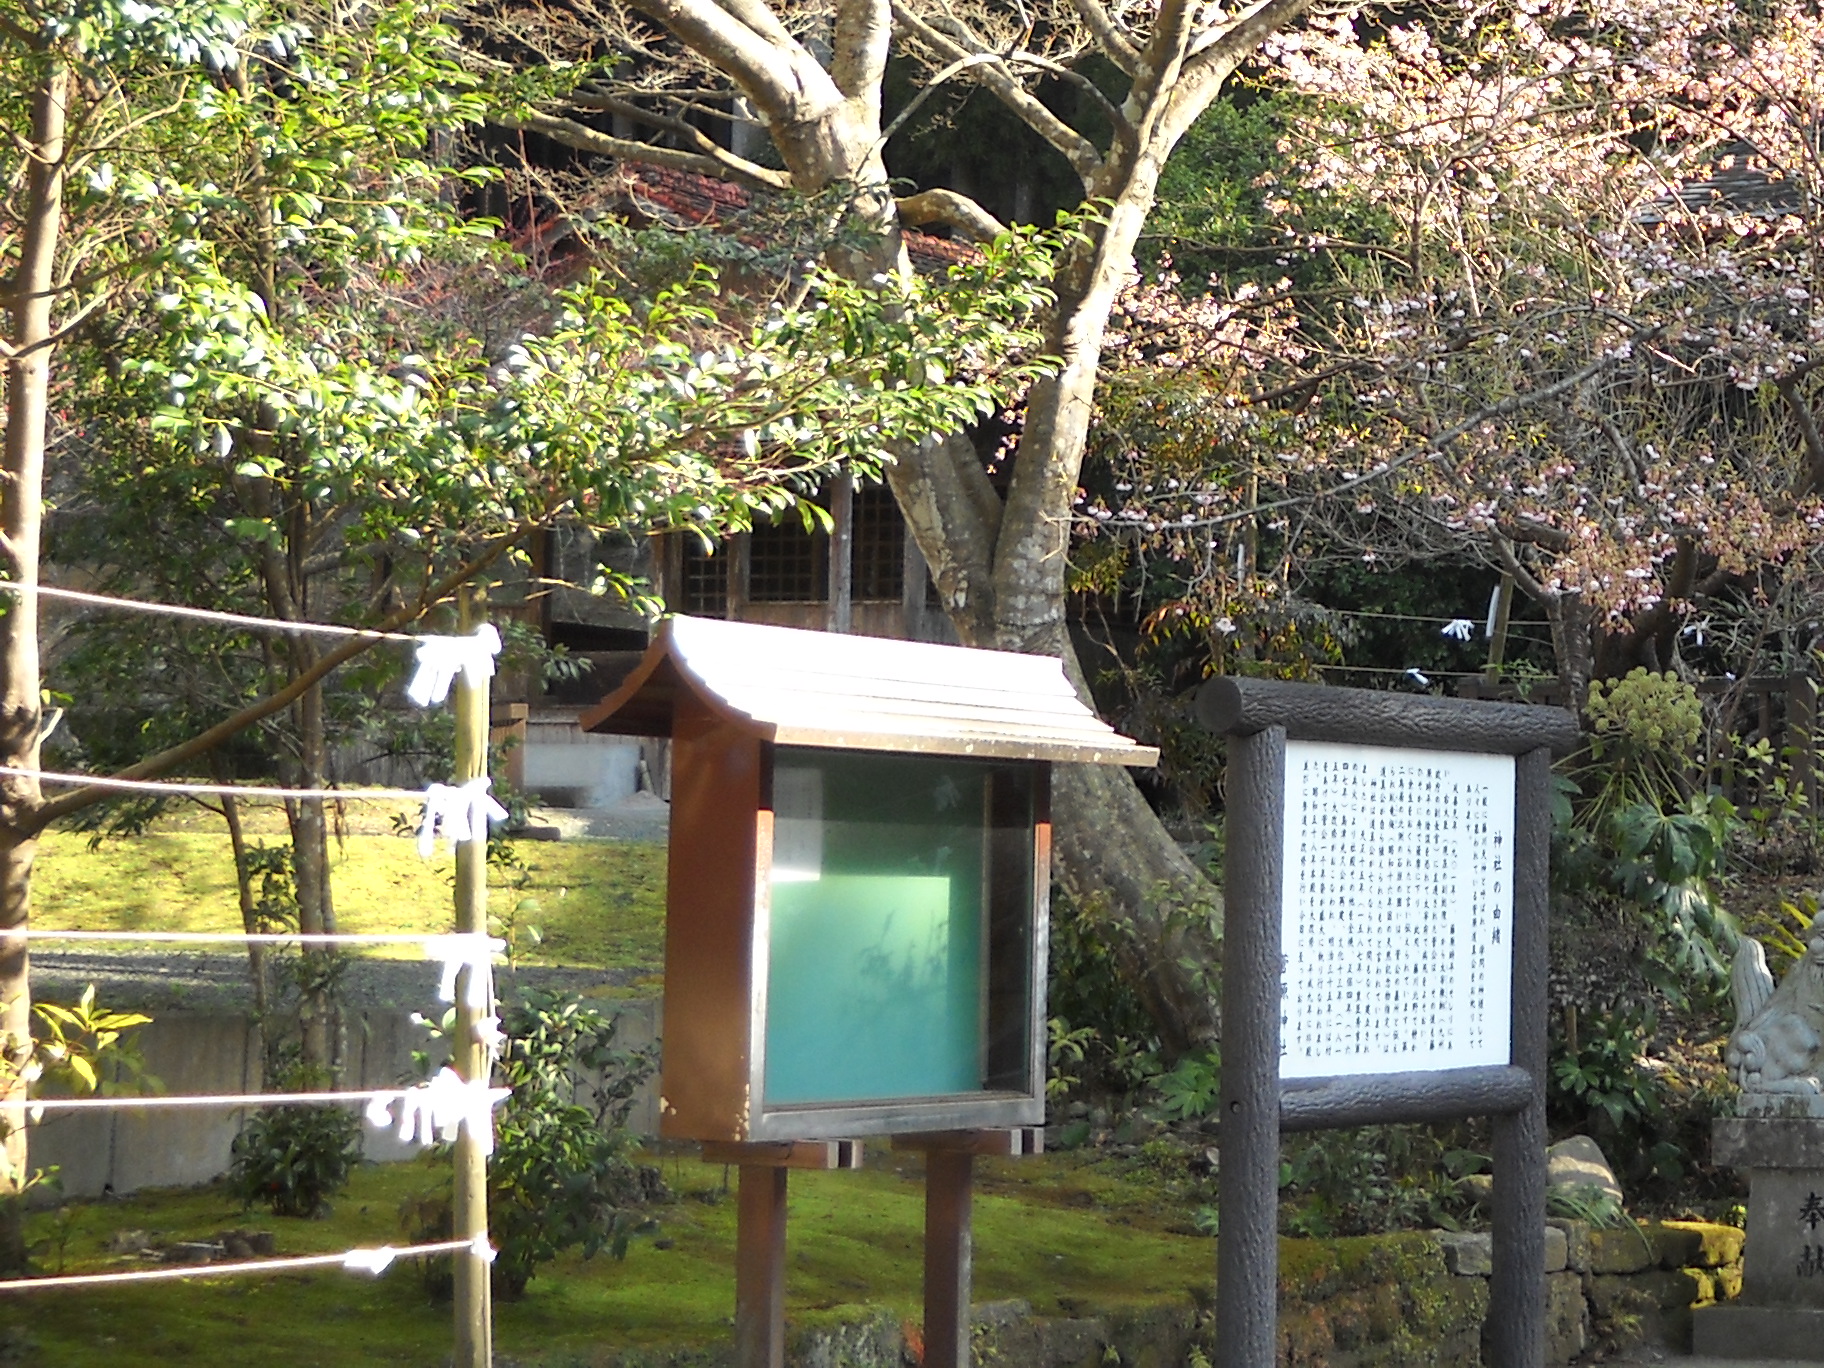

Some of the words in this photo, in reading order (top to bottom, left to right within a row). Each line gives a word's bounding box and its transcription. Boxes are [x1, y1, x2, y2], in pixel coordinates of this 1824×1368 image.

[1491, 830, 1503, 945] 神社の由緒
